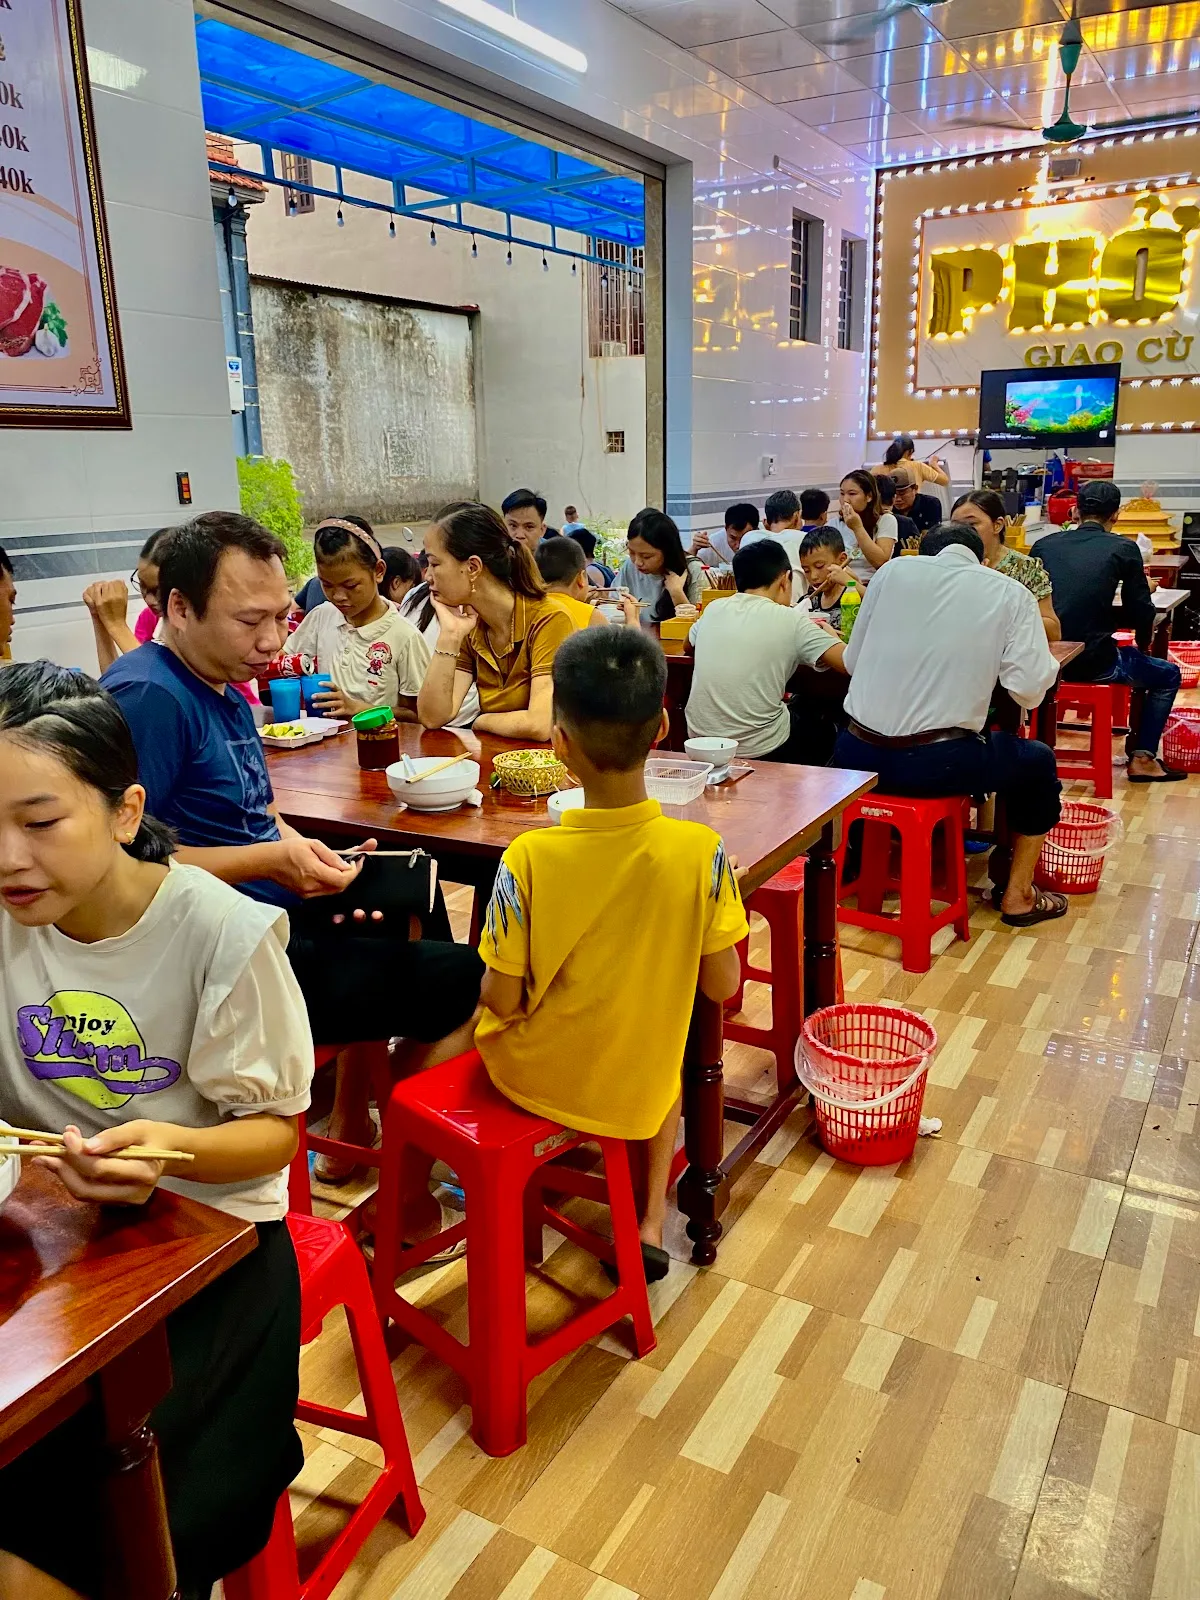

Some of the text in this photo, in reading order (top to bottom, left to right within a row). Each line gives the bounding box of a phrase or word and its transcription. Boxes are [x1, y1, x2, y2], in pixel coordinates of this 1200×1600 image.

[0, 124, 30, 152] 0k
[928, 193, 1200, 339] PHỞ
[1024, 329, 1195, 367] GIAO CÙ
[64, 1013, 117, 1035] njoy
